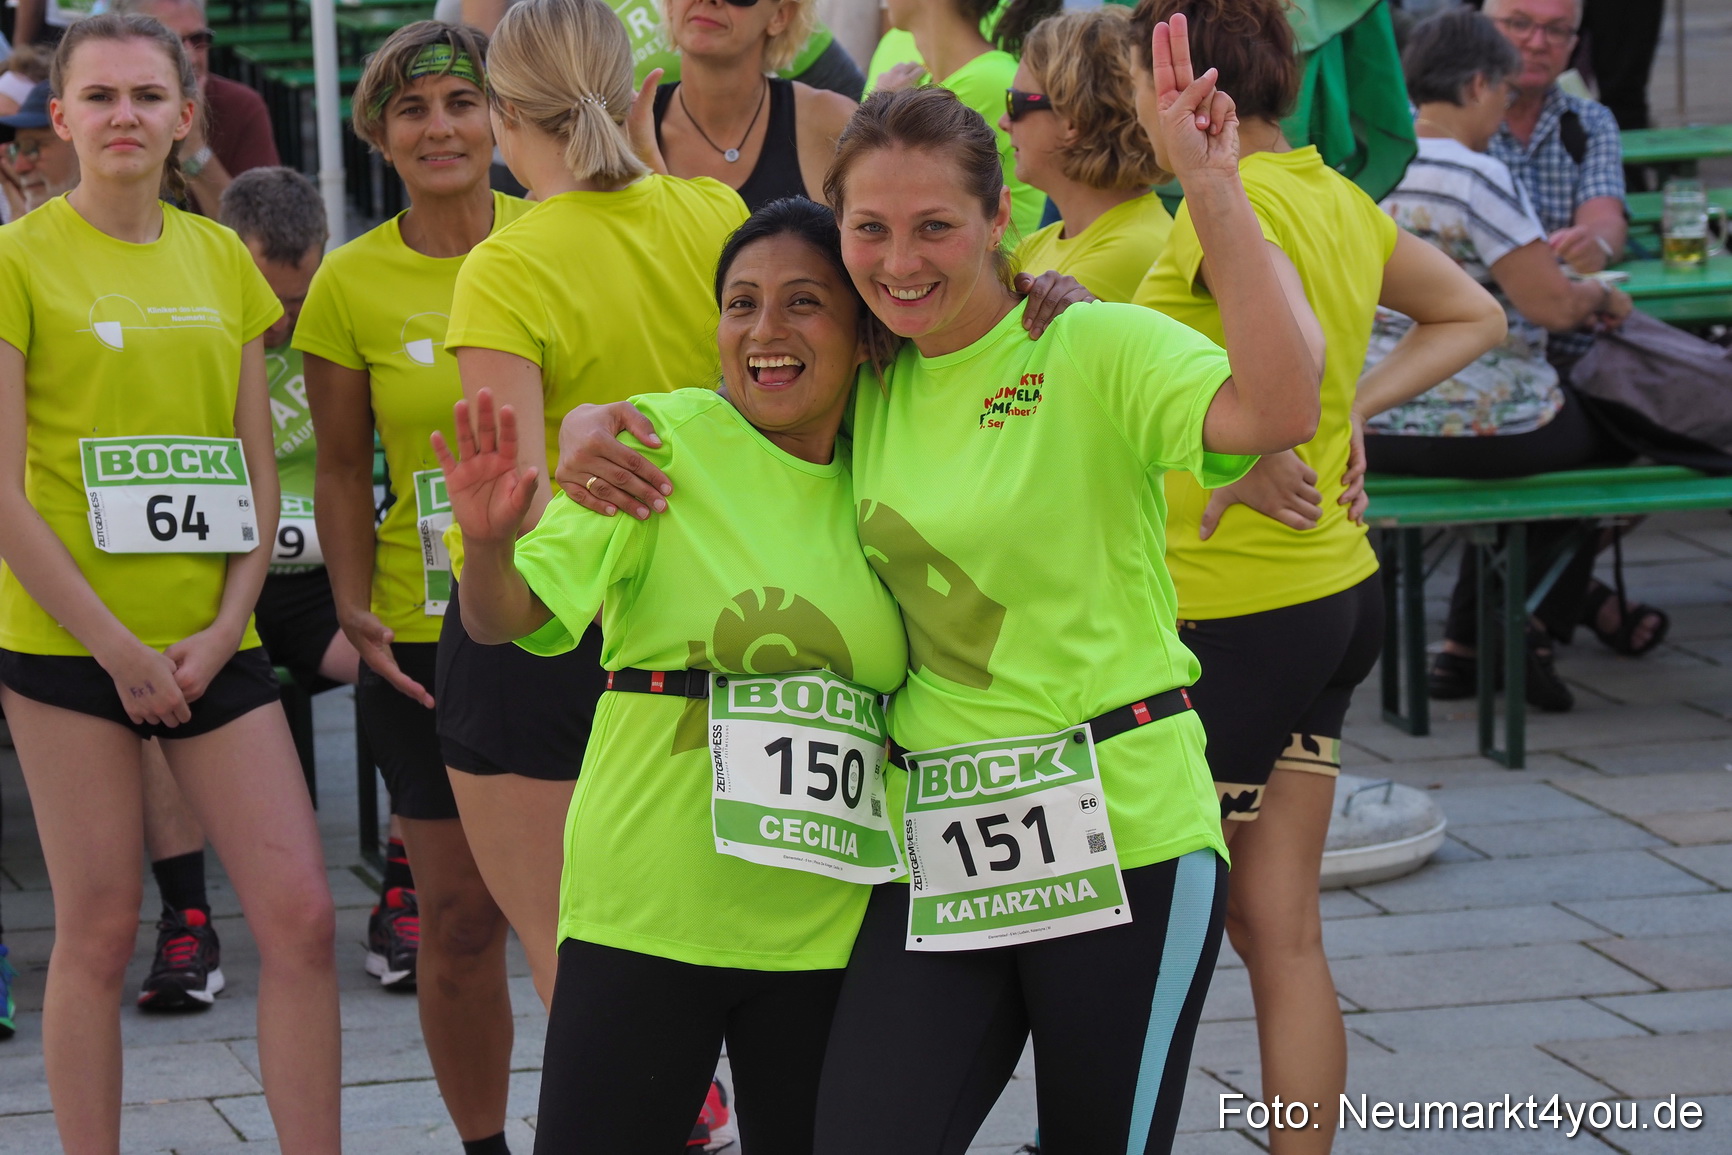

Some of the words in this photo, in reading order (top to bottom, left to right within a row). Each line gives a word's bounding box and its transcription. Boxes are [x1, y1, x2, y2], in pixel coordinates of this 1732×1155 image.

[97, 446, 234, 479] BOCK
[146, 494, 210, 542] 64
[238, 499, 249, 508] E6
[731, 678, 878, 735] BOCK
[764, 736, 865, 810] 150
[919, 742, 1072, 801] BOCK
[1080, 797, 1097, 810] E6
[759, 815, 858, 858] CECILIA
[941, 805, 1056, 878] 151
[936, 878, 1098, 924] KATARZYNA
